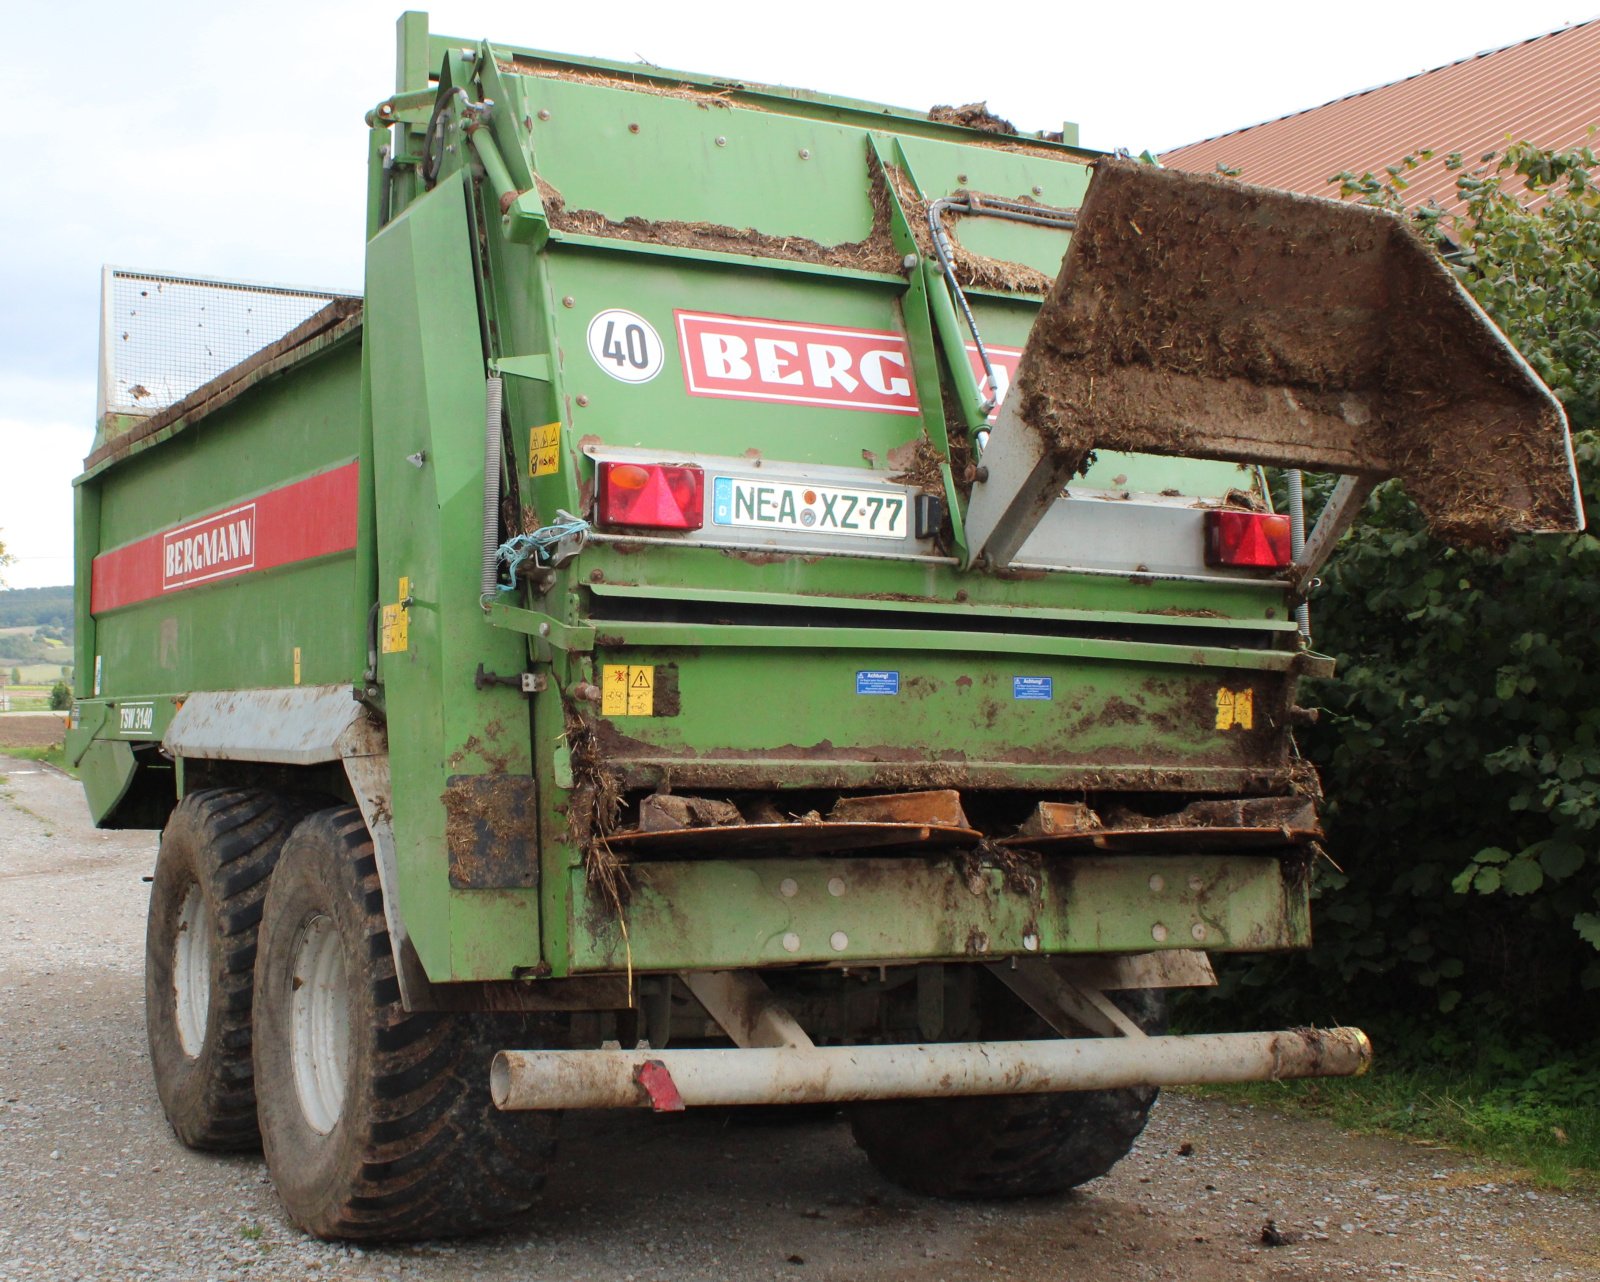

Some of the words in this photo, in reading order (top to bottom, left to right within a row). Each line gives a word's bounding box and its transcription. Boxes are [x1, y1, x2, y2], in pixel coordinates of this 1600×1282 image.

[601, 320, 649, 370] 40
[735, 485, 797, 524] NEA
[820, 493, 859, 529] XZ
[866, 497, 904, 532] 77
[165, 518, 252, 578] BERGMANN
[120, 708, 136, 729] TSW
[135, 707, 153, 729] 3140
